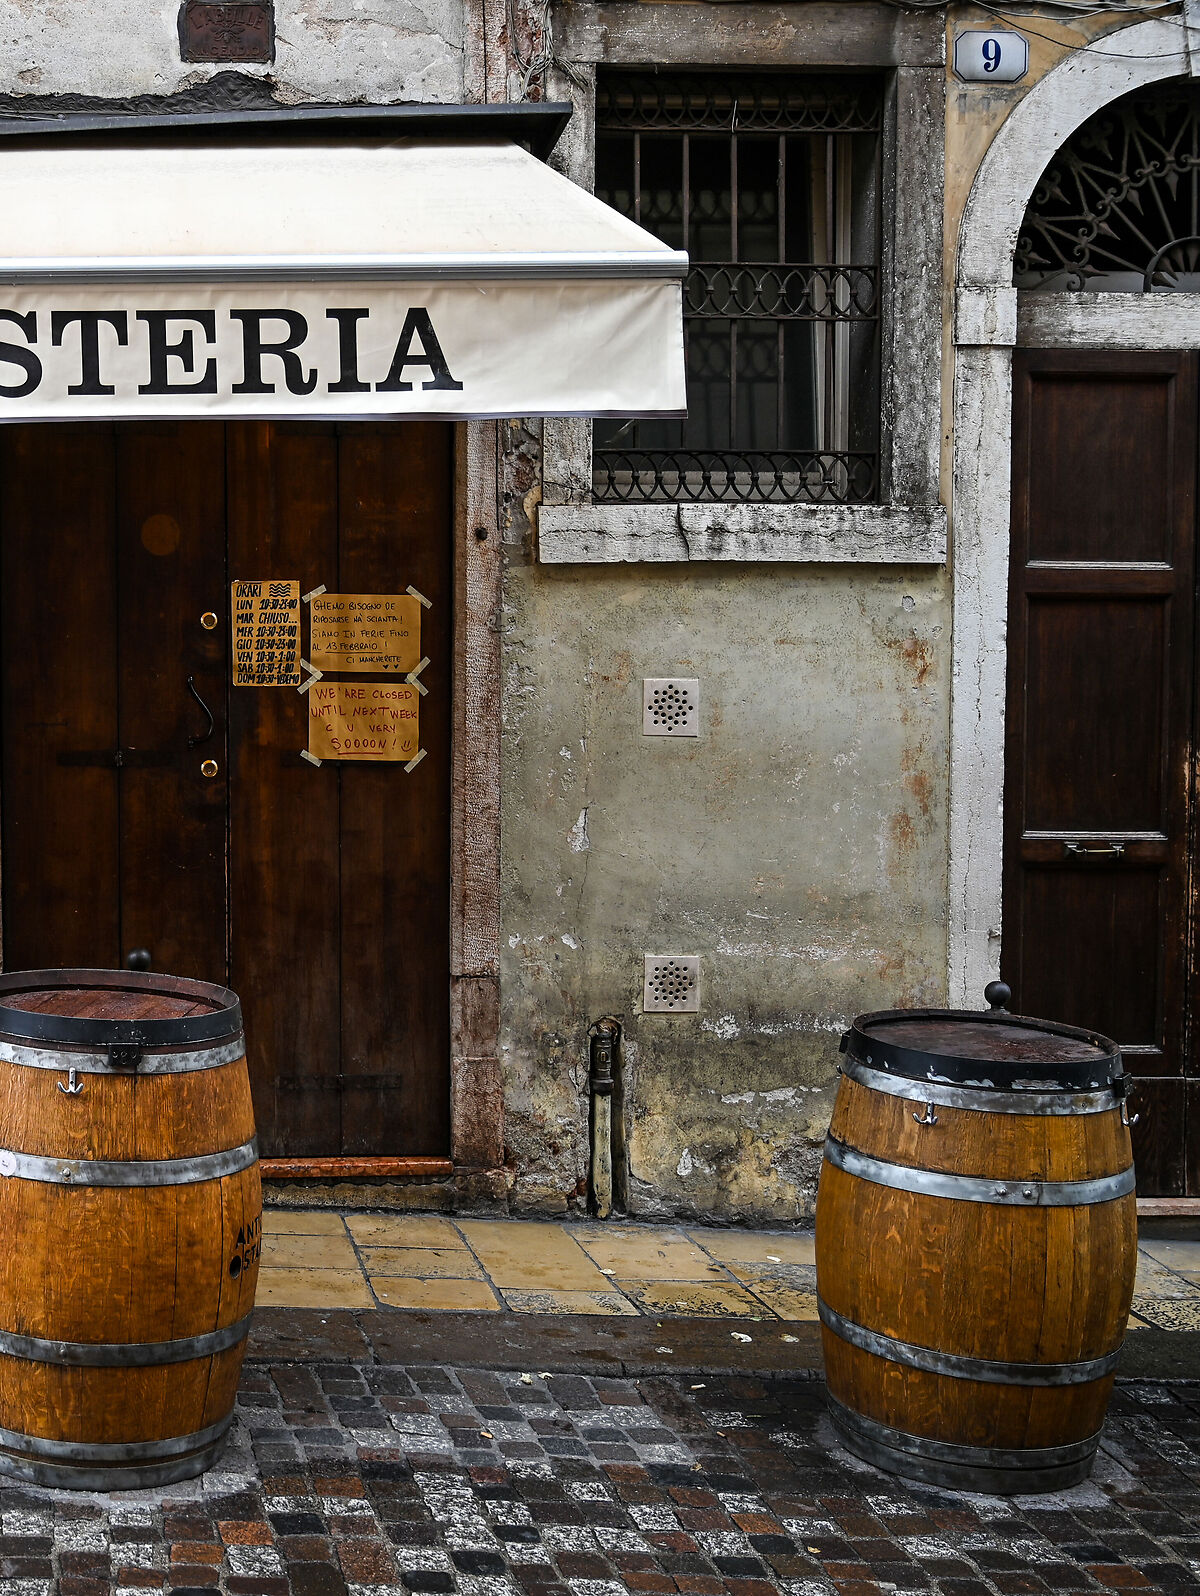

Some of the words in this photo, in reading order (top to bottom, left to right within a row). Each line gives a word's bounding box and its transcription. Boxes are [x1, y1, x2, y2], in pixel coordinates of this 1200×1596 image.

[982, 38, 1002, 72] 9
[236, 584, 261, 597] ORARI
[236, 600, 253, 610] LUN
[313, 600, 345, 611] GHEMO
[349, 602, 381, 611] BISOGNO
[385, 603, 396, 611] DE
[236, 612, 254, 624] MAR
[313, 615, 349, 624] RIPOSARSE
[236, 626, 254, 638] MER
[312, 629, 339, 638] SIAMO
[343, 630, 356, 638] IN
[361, 629, 385, 638] FERIE
[390, 629, 409, 637] FINO
[236, 639, 253, 650] GIO
[326, 642, 338, 650] 13
[340, 642, 378, 651] FEBBRAIO
[237, 652, 253, 662] VEN
[346, 656, 355, 664] CI
[360, 655, 402, 663] MANCHERETE
[238, 663, 254, 673] SAB
[238, 673, 255, 684] DOM
[372, 690, 413, 700] CLOSED
[310, 705, 347, 718] UNTIL
[352, 706, 390, 717] NEXT
[390, 709, 417, 719] WEEK
[325, 724, 333, 732] C
[347, 723, 354, 732] U
[369, 724, 396, 734] VERY
